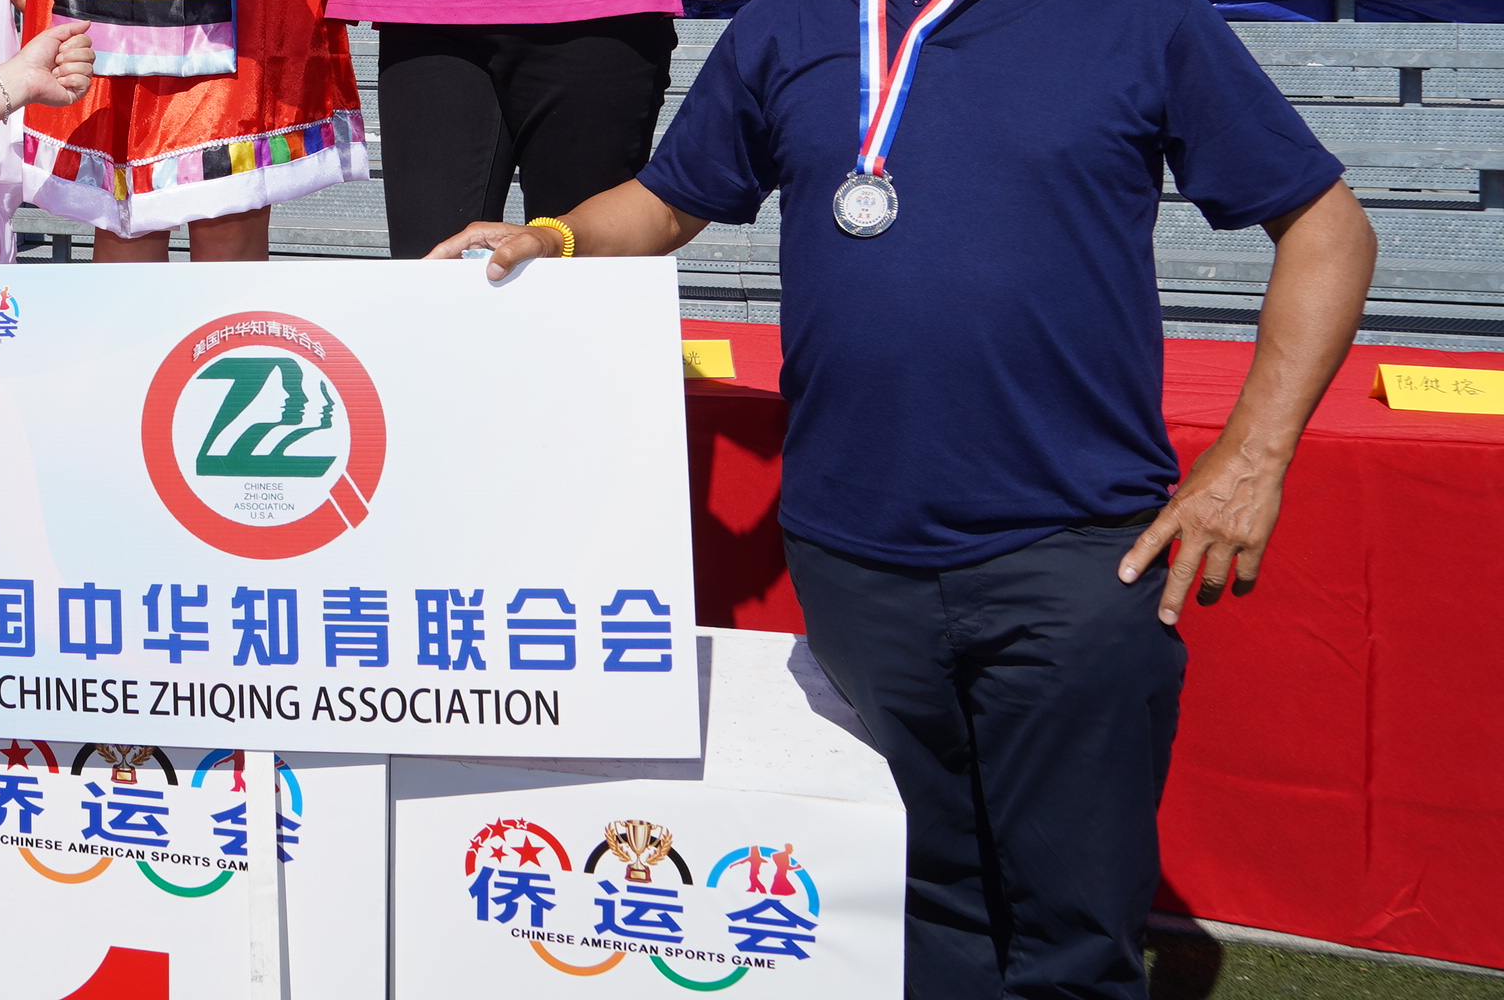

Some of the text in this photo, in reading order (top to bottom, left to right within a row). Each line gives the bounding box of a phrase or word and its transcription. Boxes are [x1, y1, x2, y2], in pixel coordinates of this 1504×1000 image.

[192, 320, 326, 362] 美国中华知青联合会
[243, 482, 284, 491] CHINESE
[243, 492, 284, 501] ZHI-QING
[233, 502, 295, 511] ASSOCIATION
[250, 511, 276, 520] U.S.A.
[149, 681, 301, 724] ZHIQING
[311, 686, 561, 727] ASSOCIATION
[0, 834, 63, 851] CHINESE
[67, 842, 146, 861] AMERICAN
[150, 851, 211, 868] SPORTS
[468, 866, 818, 960] 侨运会
[510, 927, 777, 970] CHINESE AMERICAN SPORTS GAME
